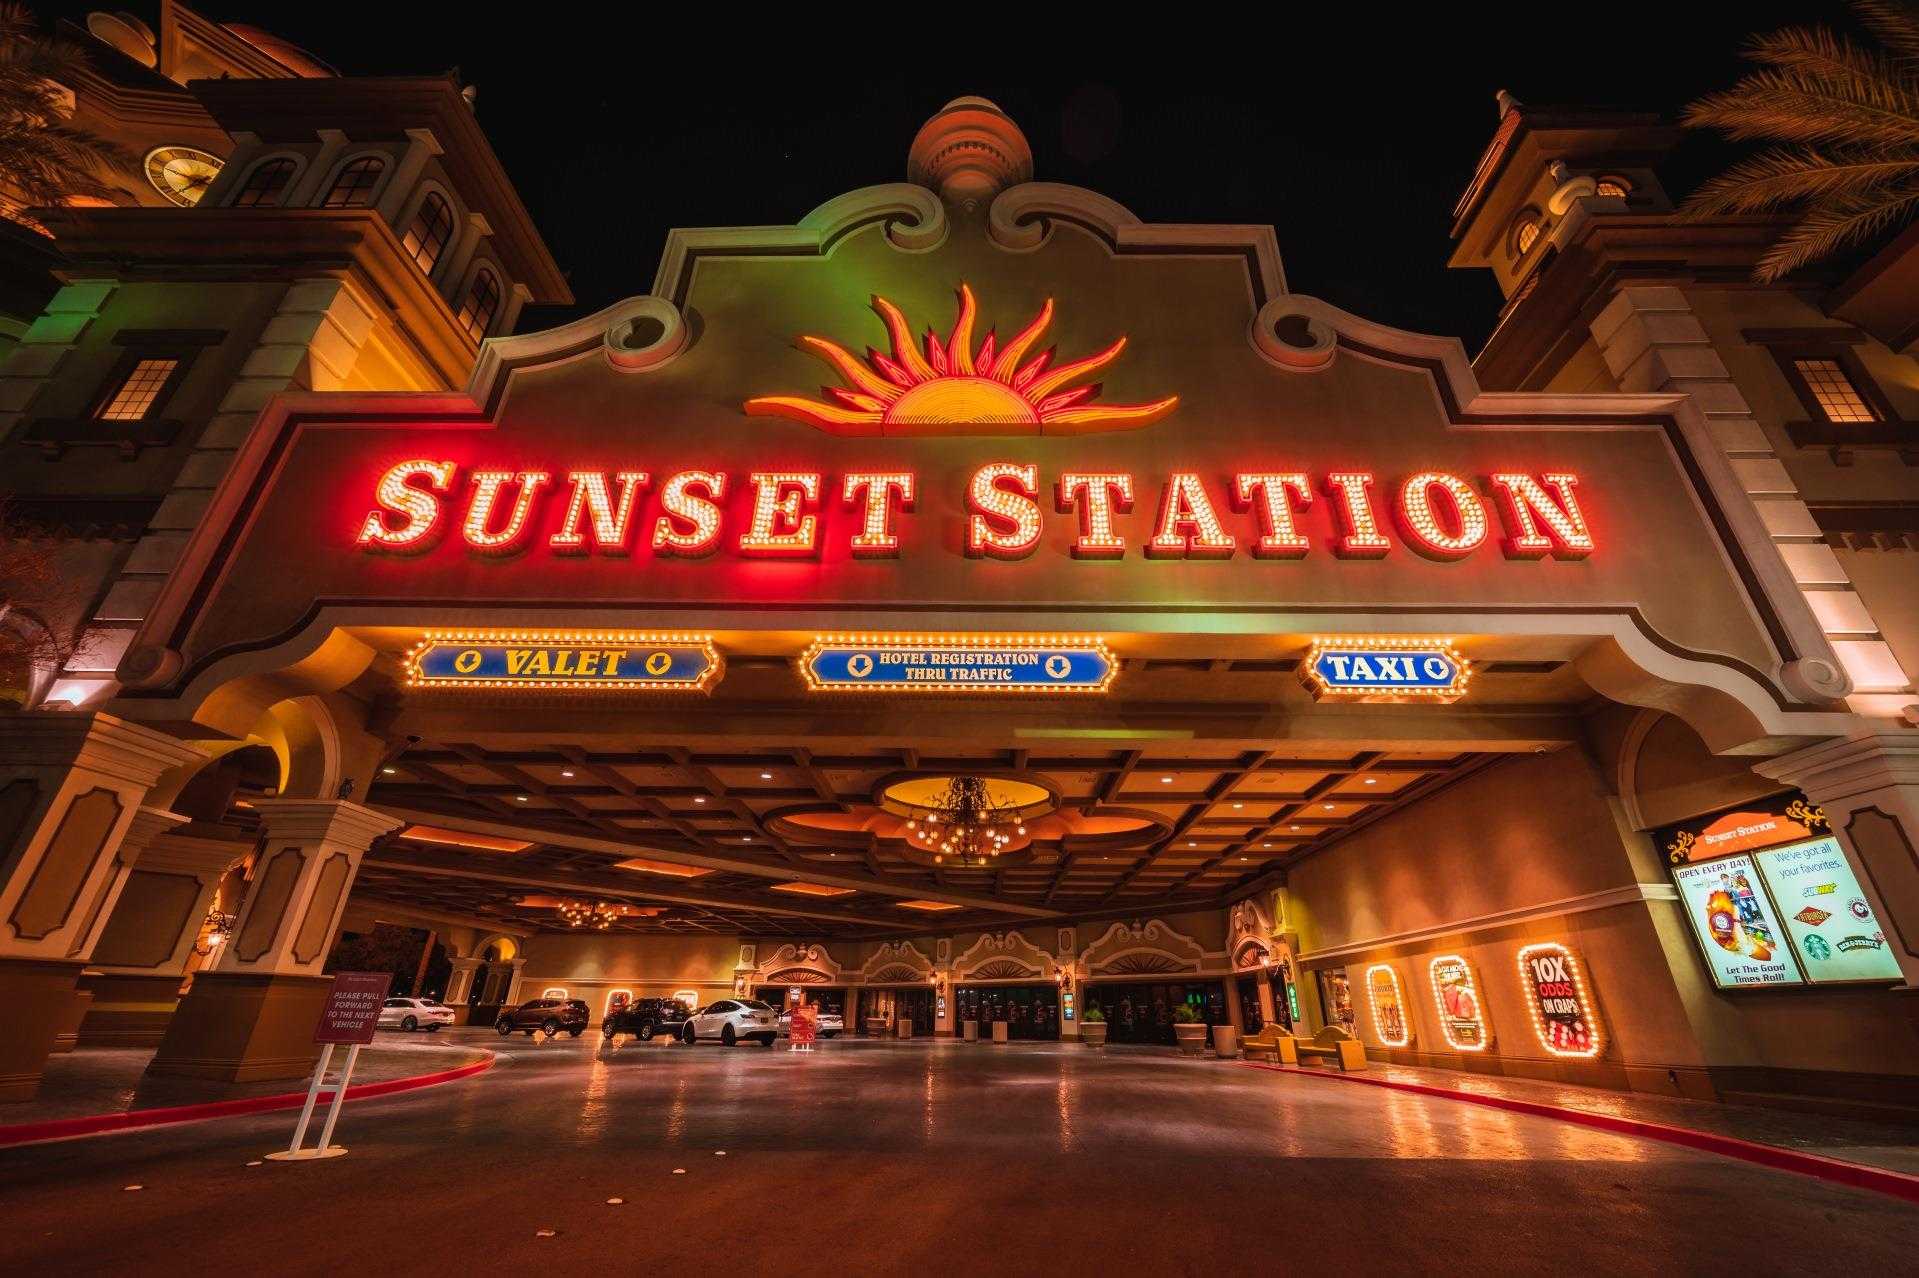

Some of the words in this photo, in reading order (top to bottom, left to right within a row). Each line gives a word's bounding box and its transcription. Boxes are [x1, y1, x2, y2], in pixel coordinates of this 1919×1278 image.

[356, 459, 915, 552] SUNSET
[967, 462, 1596, 556] STATION
[505, 650, 627, 677] VALET
[879, 652, 927, 665] HOTEL
[931, 652, 1039, 665] REGISTRATION
[905, 668, 947, 681] THRU
[950, 668, 1013, 681] TRAFFIC
[1327, 656, 1420, 681] TAXI
[1737, 821, 1777, 837] STATION
[1774, 850, 1801, 863] We've
[1803, 847, 1821, 860] got
[1821, 842, 1833, 855] all
[1679, 868, 1700, 879] OPEN
[1702, 863, 1727, 875] EVERY
[1730, 857, 1751, 869] DAY!
[1780, 868, 1799, 880] your
[1531, 956, 1571, 983] 10X
[1726, 966, 1741, 975] Let
[1743, 964, 1759, 973] The
[1761, 962, 1786, 972] Good
[1734, 975, 1761, 984] Times
[1763, 972, 1785, 982] Roll!
[362, 992, 379, 1000] PULL
[1540, 982, 1573, 997] ODDS
[335, 1001, 373, 1009] FORWARD
[1543, 999, 1556, 1013] ON
[328, 1010, 338, 1018] TO
[354, 1011, 376, 1019] NEXT
[332, 1020, 365, 1028] VEHICLE
